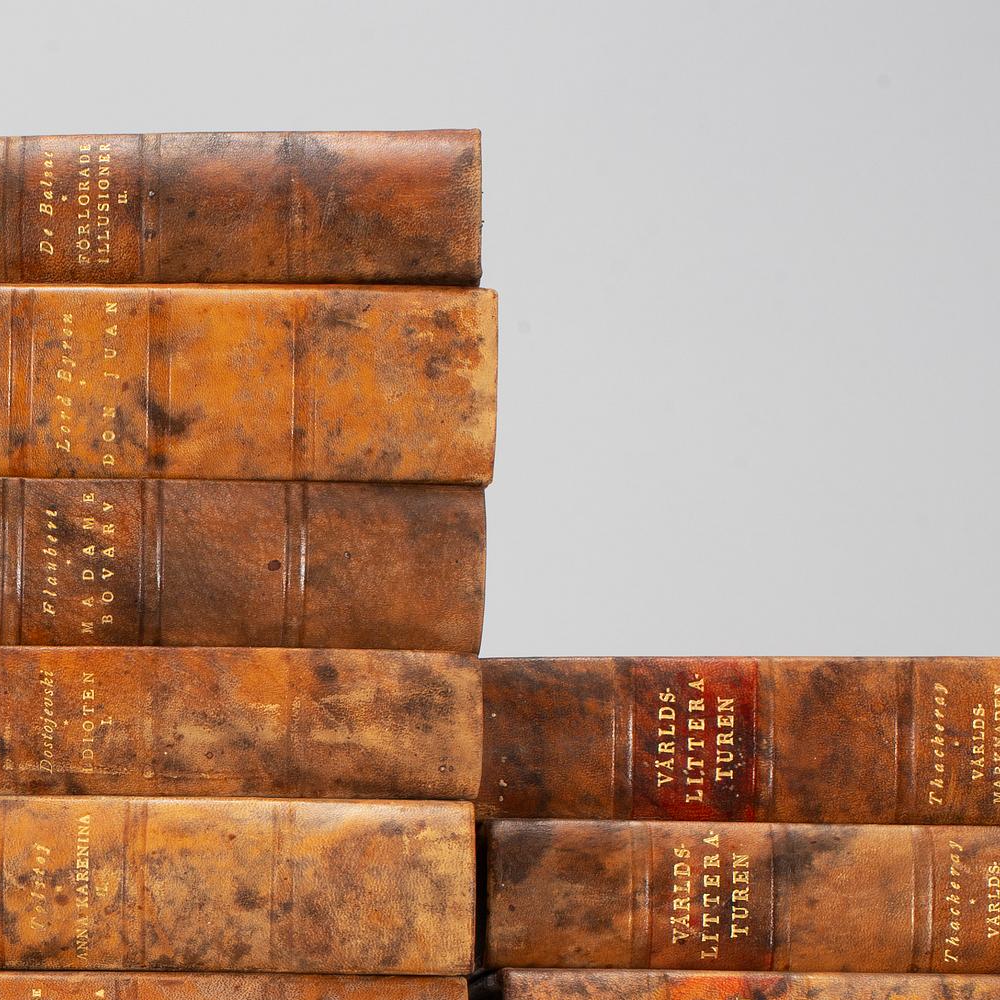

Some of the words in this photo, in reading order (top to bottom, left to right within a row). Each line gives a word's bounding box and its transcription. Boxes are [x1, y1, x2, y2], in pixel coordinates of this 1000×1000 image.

[39, 151, 54, 216] Balzac
[77, 143, 91, 265] FÖRLORADE
[97, 143, 111, 264] ILLUSIONER
[39, 227, 54, 256] De
[56, 312, 77, 383] Byron
[103, 300, 121, 379] JUAN
[55, 394, 72, 453] Lord
[101, 405, 117, 467] DON
[42, 508, 58, 617] Flaubert
[80, 492, 96, 635] MADAME
[101, 501, 116, 626] BOVARY
[39, 668, 57, 775] Dostojevski
[81, 670, 96, 775] IDIOTEN
[654, 686, 676, 788] VÄRLDS-
[685, 672, 706, 804] LITTERA-
[714, 695, 734, 782] TUREN
[928, 682, 949, 806] Thackeray
[971, 703, 985, 781] VÄRLDS-
[30, 841, 51, 931] Tolstoj
[76, 813, 91, 909] KARENINA
[669, 842, 691, 945] VÄRLDS-
[700, 830, 721, 961] LITTERA-
[730, 852, 750, 939] TUREN
[943, 839, 964, 964] Thackeray
[76, 915, 91, 962] ANNA
